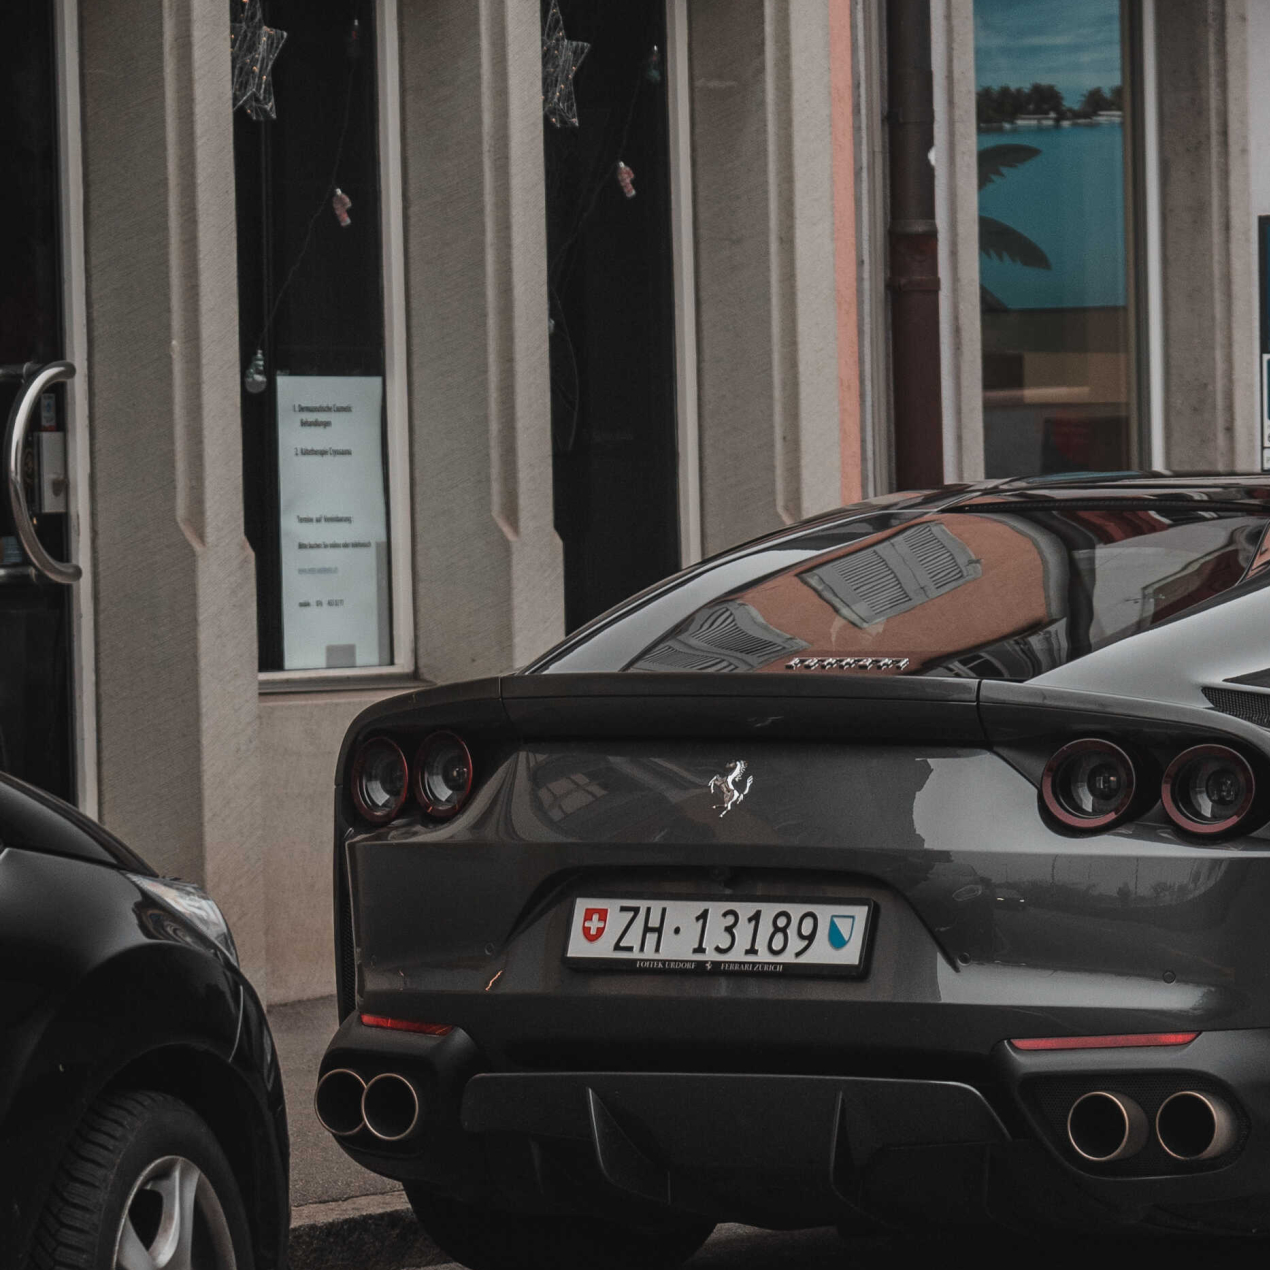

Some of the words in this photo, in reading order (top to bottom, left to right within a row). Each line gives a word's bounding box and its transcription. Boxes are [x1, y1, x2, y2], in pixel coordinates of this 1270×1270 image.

[636, 960, 664, 969] FOITEK
[665, 961, 697, 969] URDORF
[720, 962, 752, 971] FERRARI
[753, 962, 783, 972] ZÜRICH
